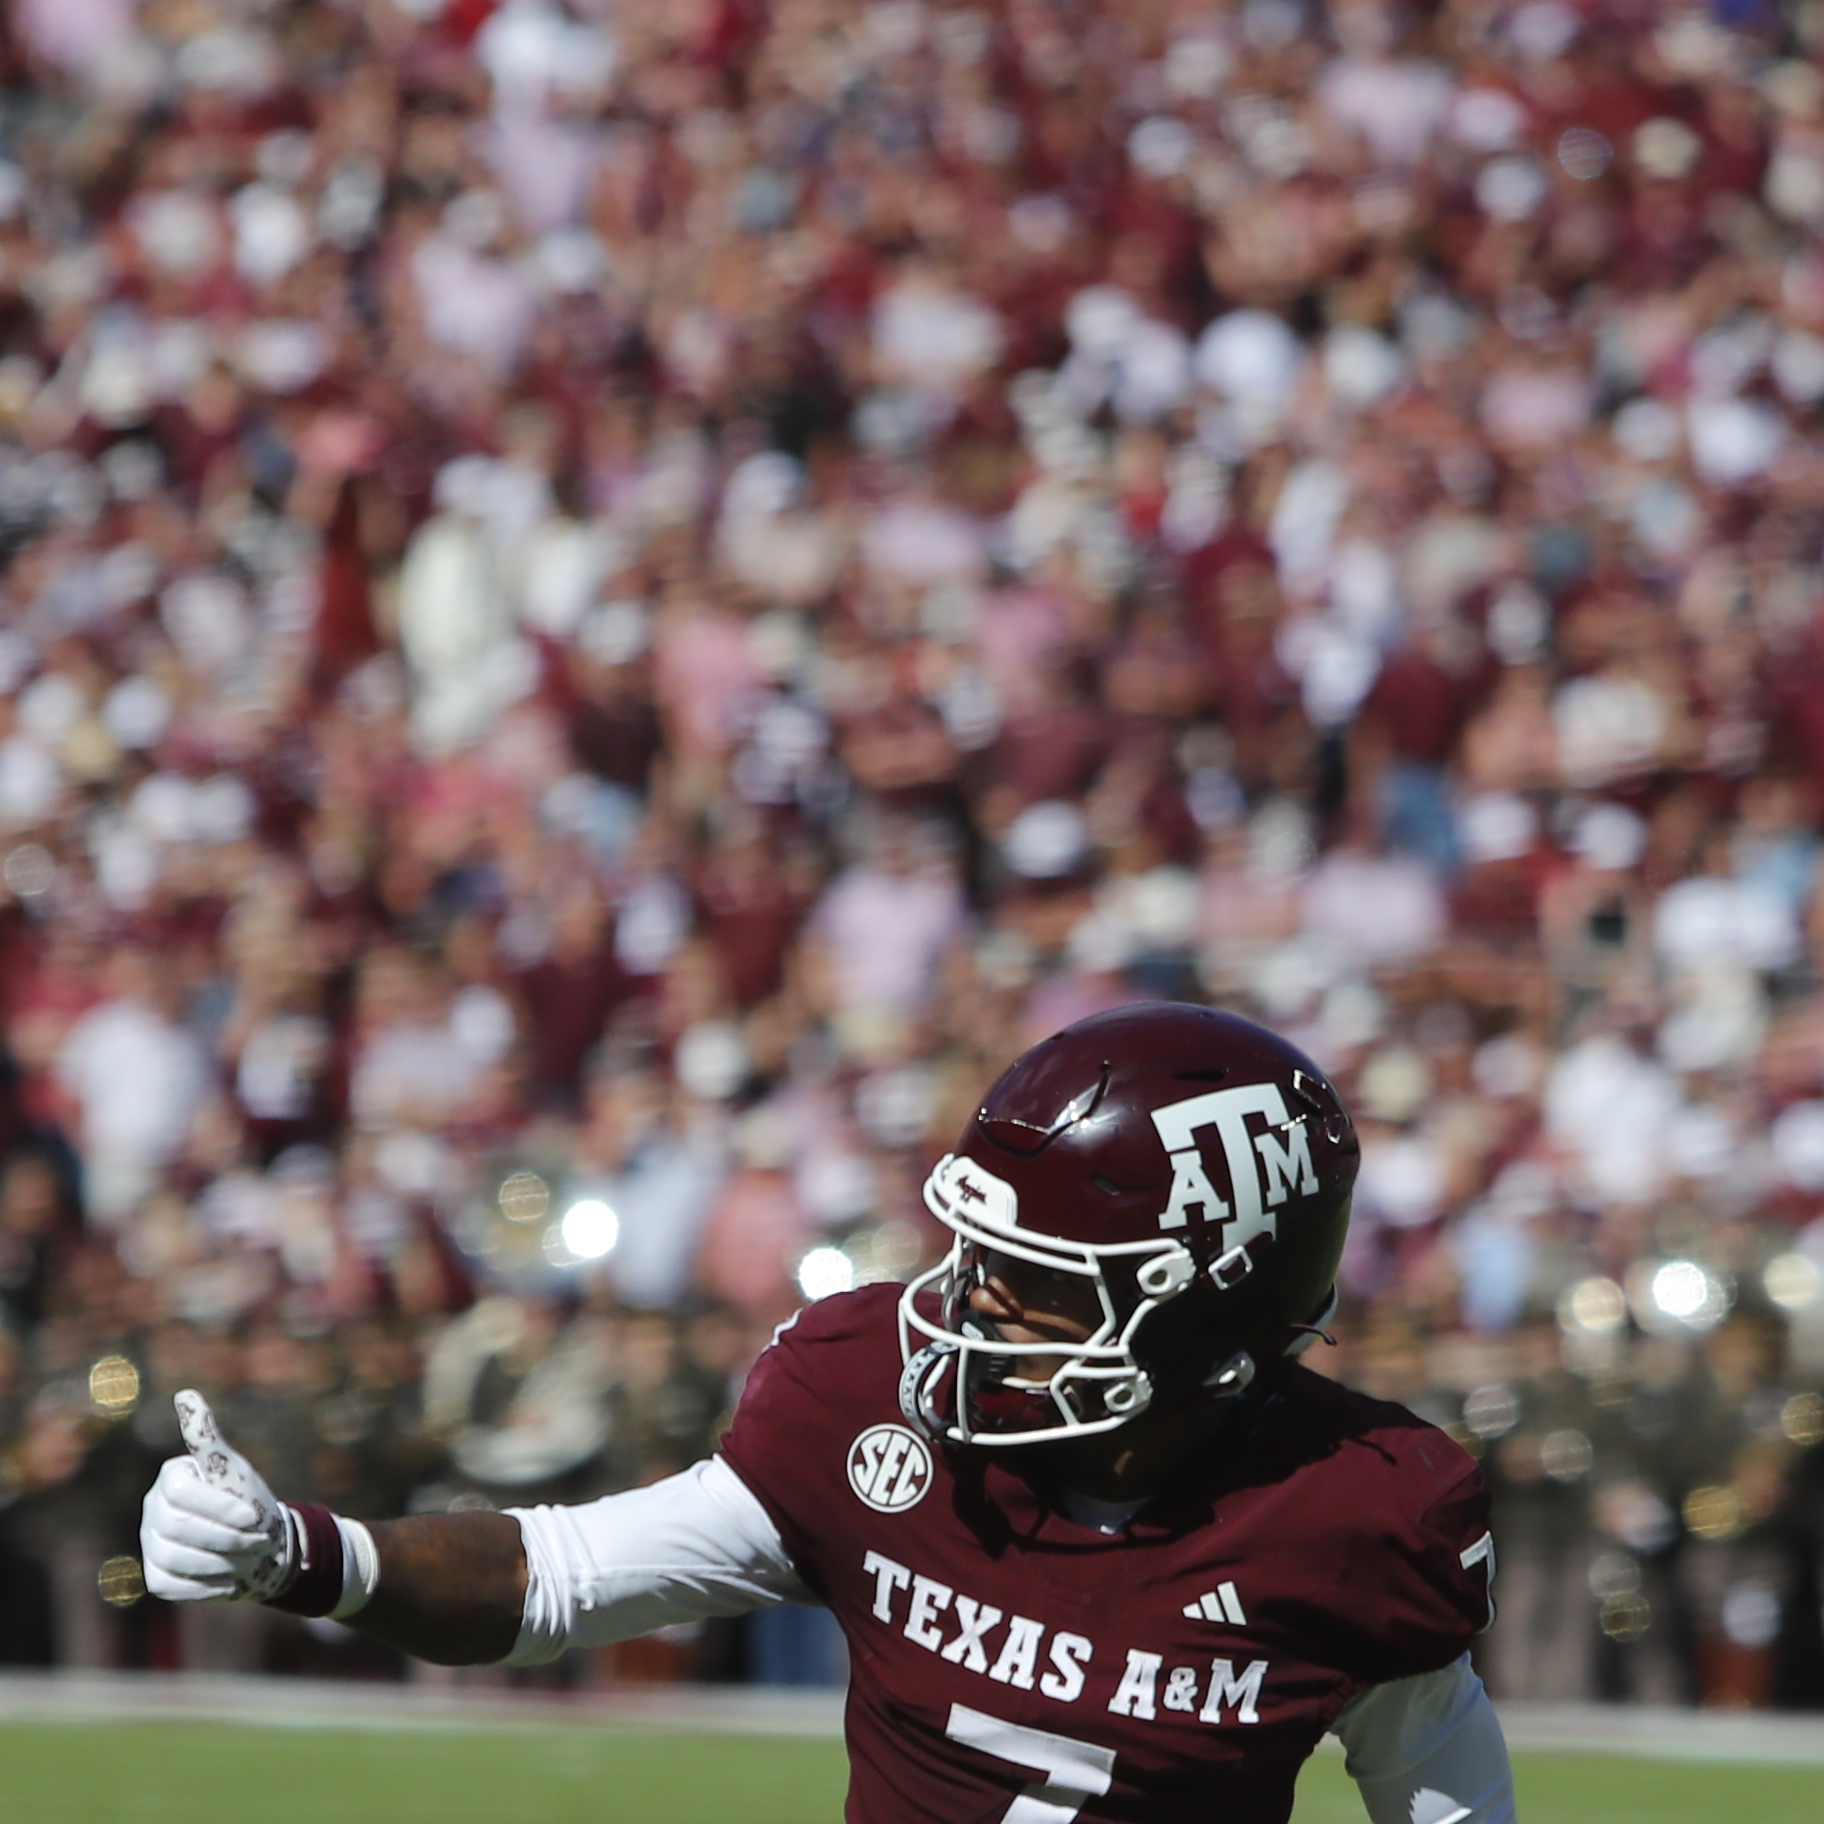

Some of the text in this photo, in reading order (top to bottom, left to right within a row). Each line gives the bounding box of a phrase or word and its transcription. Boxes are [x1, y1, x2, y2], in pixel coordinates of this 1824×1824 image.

[853, 1430, 927, 1506] SEC
[863, 1550, 1269, 1724] TEXAS A&M
